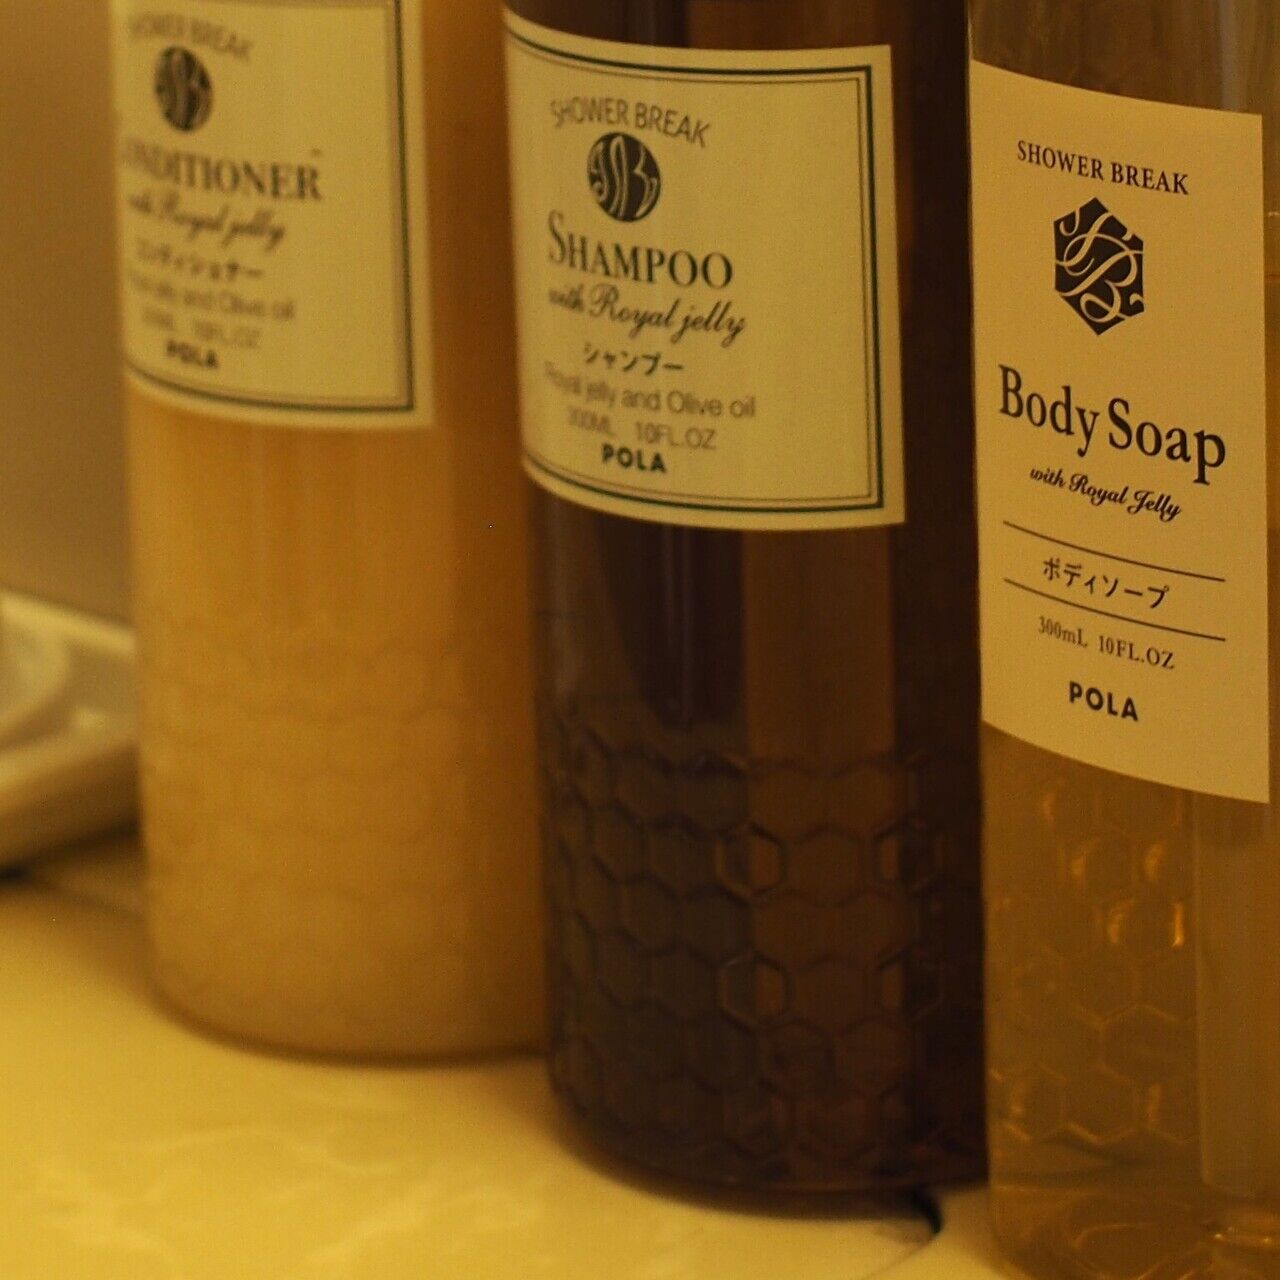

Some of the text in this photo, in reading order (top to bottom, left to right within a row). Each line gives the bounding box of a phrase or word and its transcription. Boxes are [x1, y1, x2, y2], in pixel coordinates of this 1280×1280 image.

[550, 95, 710, 149] SHOWER BREAK
[1017, 139, 1190, 196] SHOWER BREAK
[548, 209, 734, 289] SHAMPOO
[589, 283, 681, 340] Royal
[670, 298, 746, 349] jelly
[622, 390, 661, 411] and
[667, 389, 722, 417] Olive
[729, 396, 756, 419] oil
[998, 363, 1227, 486] Body Soap
[602, 442, 667, 473] POLA
[1029, 466, 1182, 523] with Royal Jelly
[1042, 557, 1170, 609] ボディソープ
[1037, 615, 1175, 670] 300mL 10FL.OZ
[1069, 680, 1139, 722] POLA
